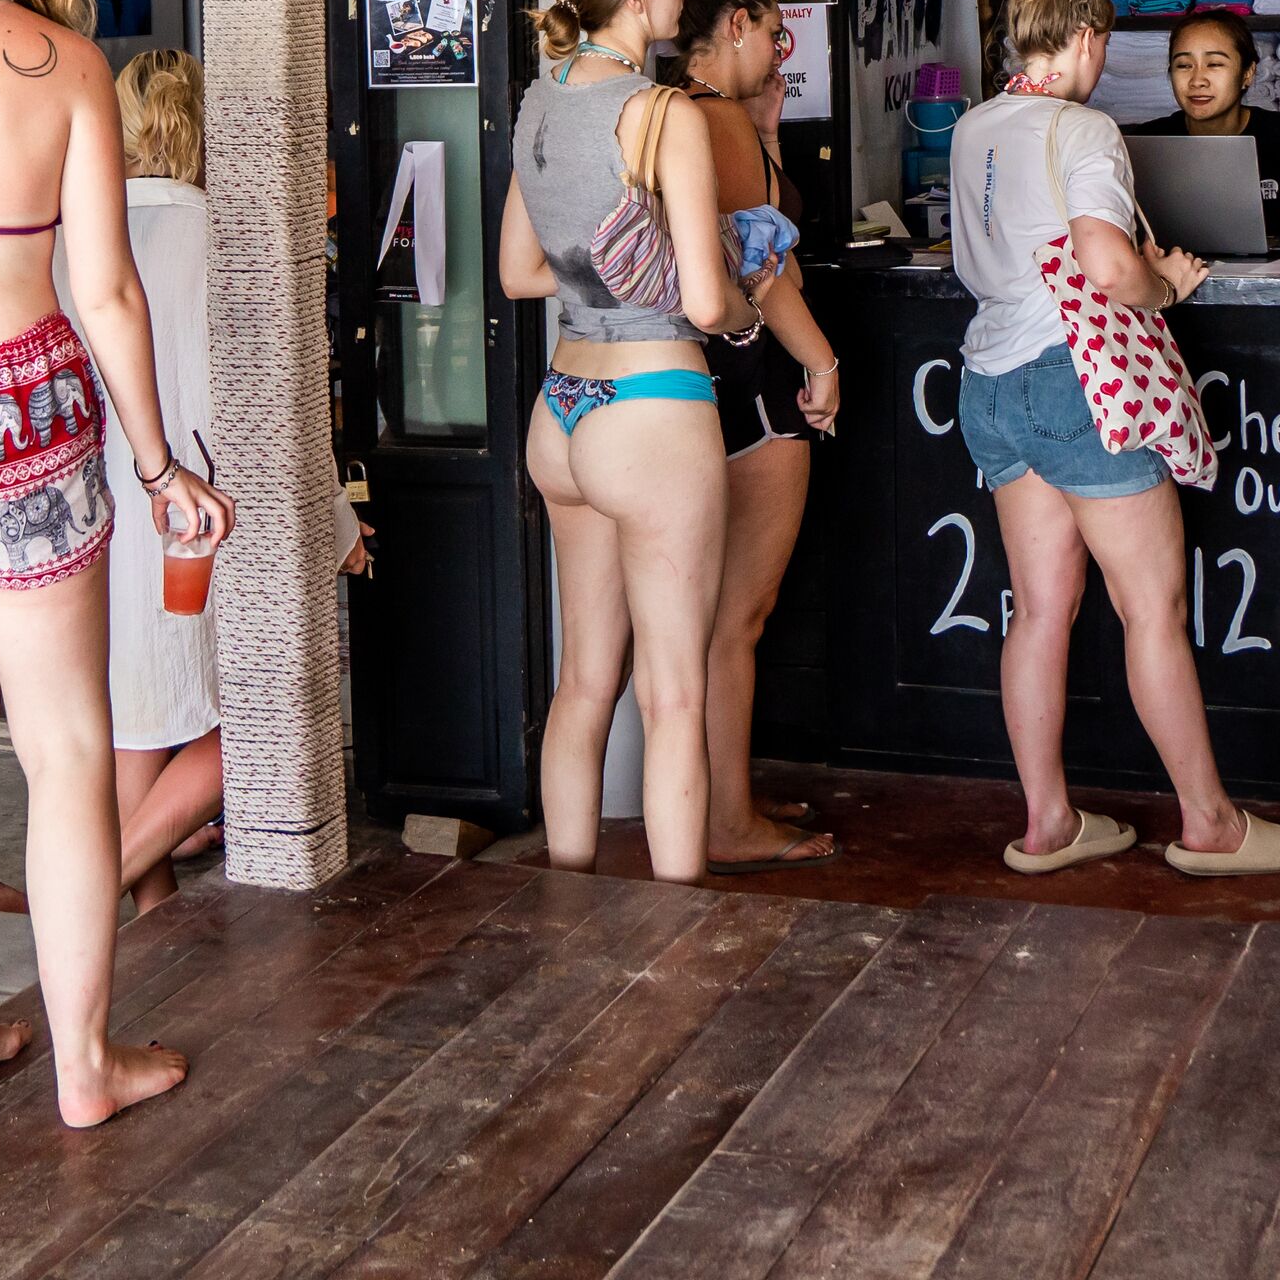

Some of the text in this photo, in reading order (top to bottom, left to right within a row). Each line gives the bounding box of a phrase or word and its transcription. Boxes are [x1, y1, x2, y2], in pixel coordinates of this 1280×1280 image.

[780, 7, 813, 19] ENALTY
[783, 72, 808, 85] TSIDE
[986, 149, 994, 170] SUN
[983, 193, 991, 237] FOLLOW
[927, 512, 989, 635] 2
[1195, 546, 1272, 654] 12
